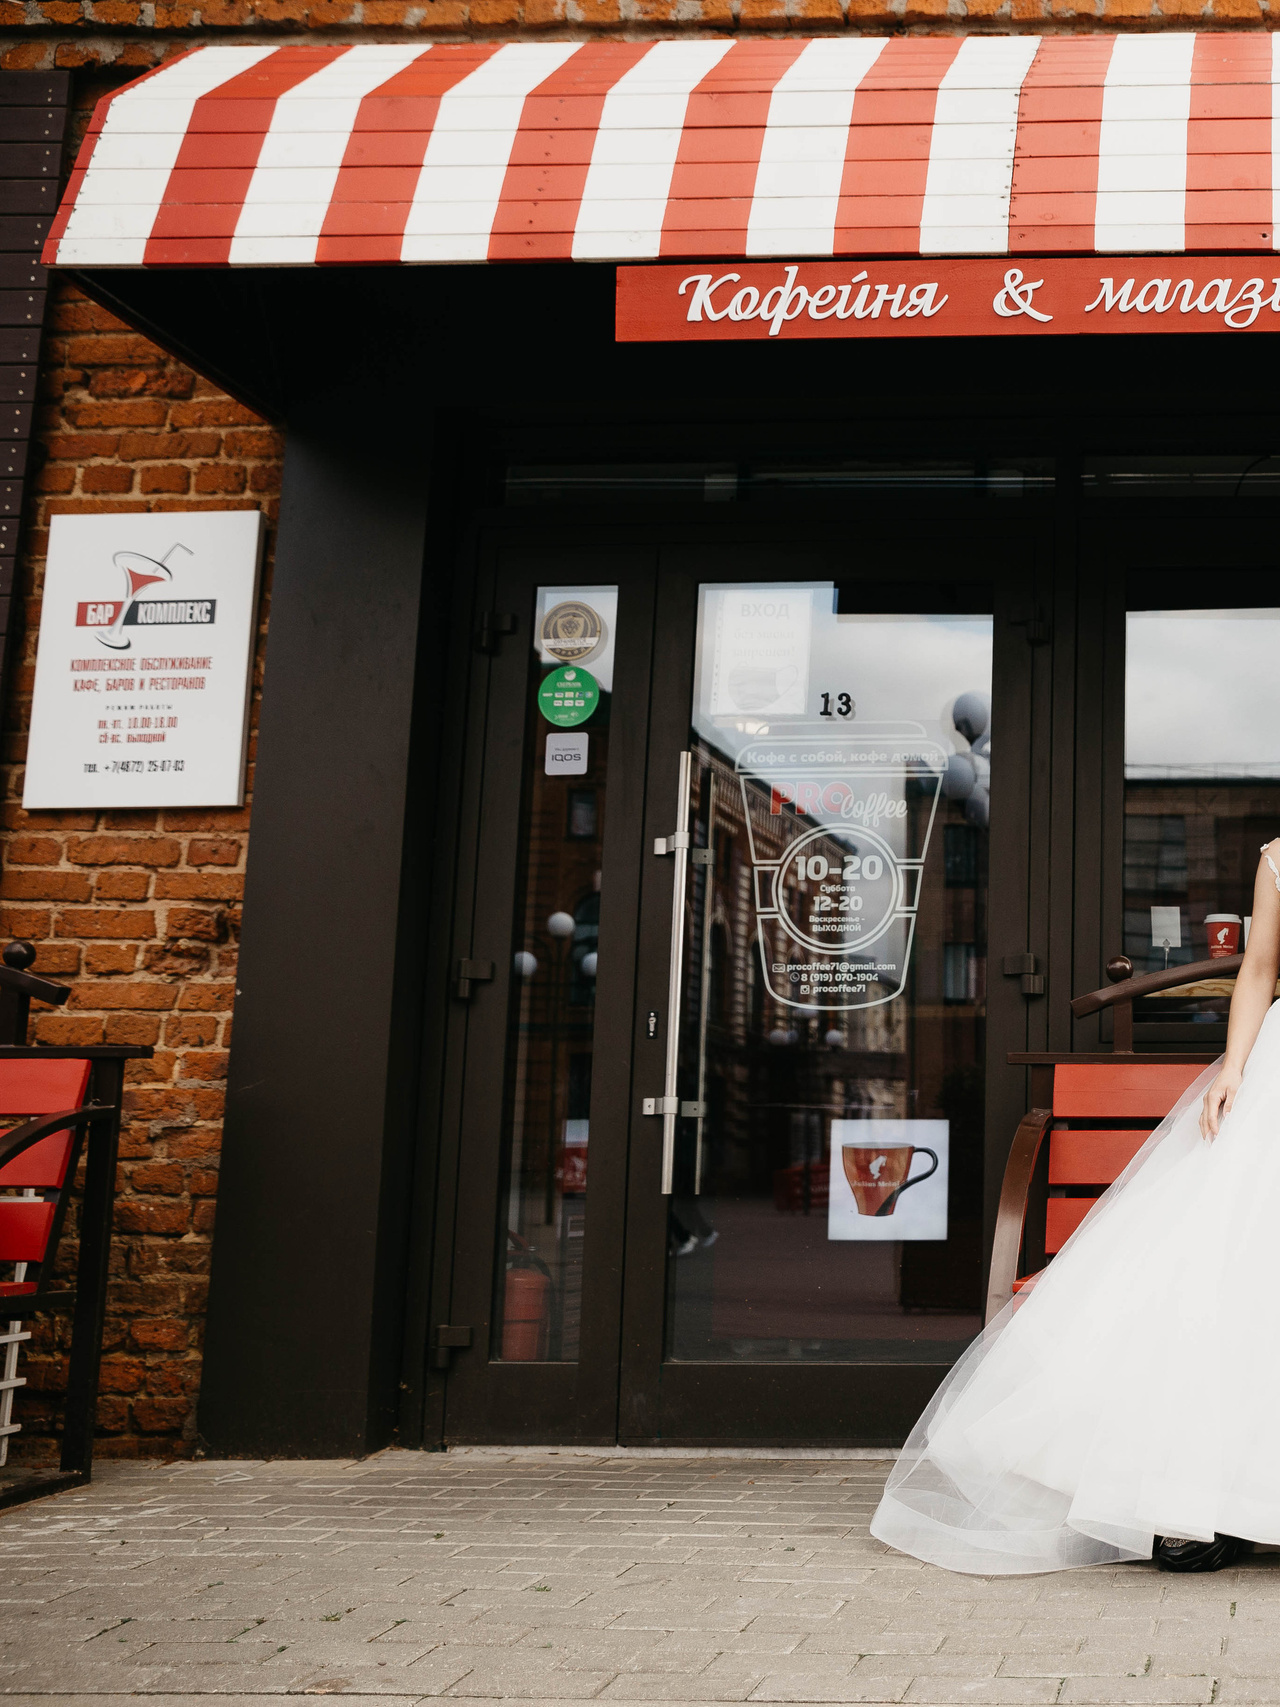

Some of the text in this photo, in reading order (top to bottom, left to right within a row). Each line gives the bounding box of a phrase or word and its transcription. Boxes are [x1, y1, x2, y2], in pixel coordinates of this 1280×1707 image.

[677, 265, 949, 337] Кофейня
[992, 268, 1054, 323] &
[85, 601, 212, 625] БАР КОМПЛЕКС
[741, 603, 790, 619] ВХОД
[70, 656, 213, 672] КОМПЛЕКСНОЕ ОБСЛУЖИВАНИЕ
[73, 676, 206, 693] КАФЕ, БАРОВ И РЕСТОРАНОВ
[820, 692, 853, 717] 13
[746, 750, 939, 765] Кофе с собой, кофе домой
[770, 781, 909, 828] PRO Coffee
[795, 855, 884, 881] 10-20
[819, 884, 856, 893] Суббота
[813, 895, 864, 911] 12-20
[808, 915, 860, 923] Воскресенье
[812, 922, 862, 932] ВЫХОДНОЙ
[786, 962, 897, 972] procoffee71@gmail.com
[801, 973, 879, 983] 8 (919) 070-1904
[812, 984, 866, 994] procoffee71
